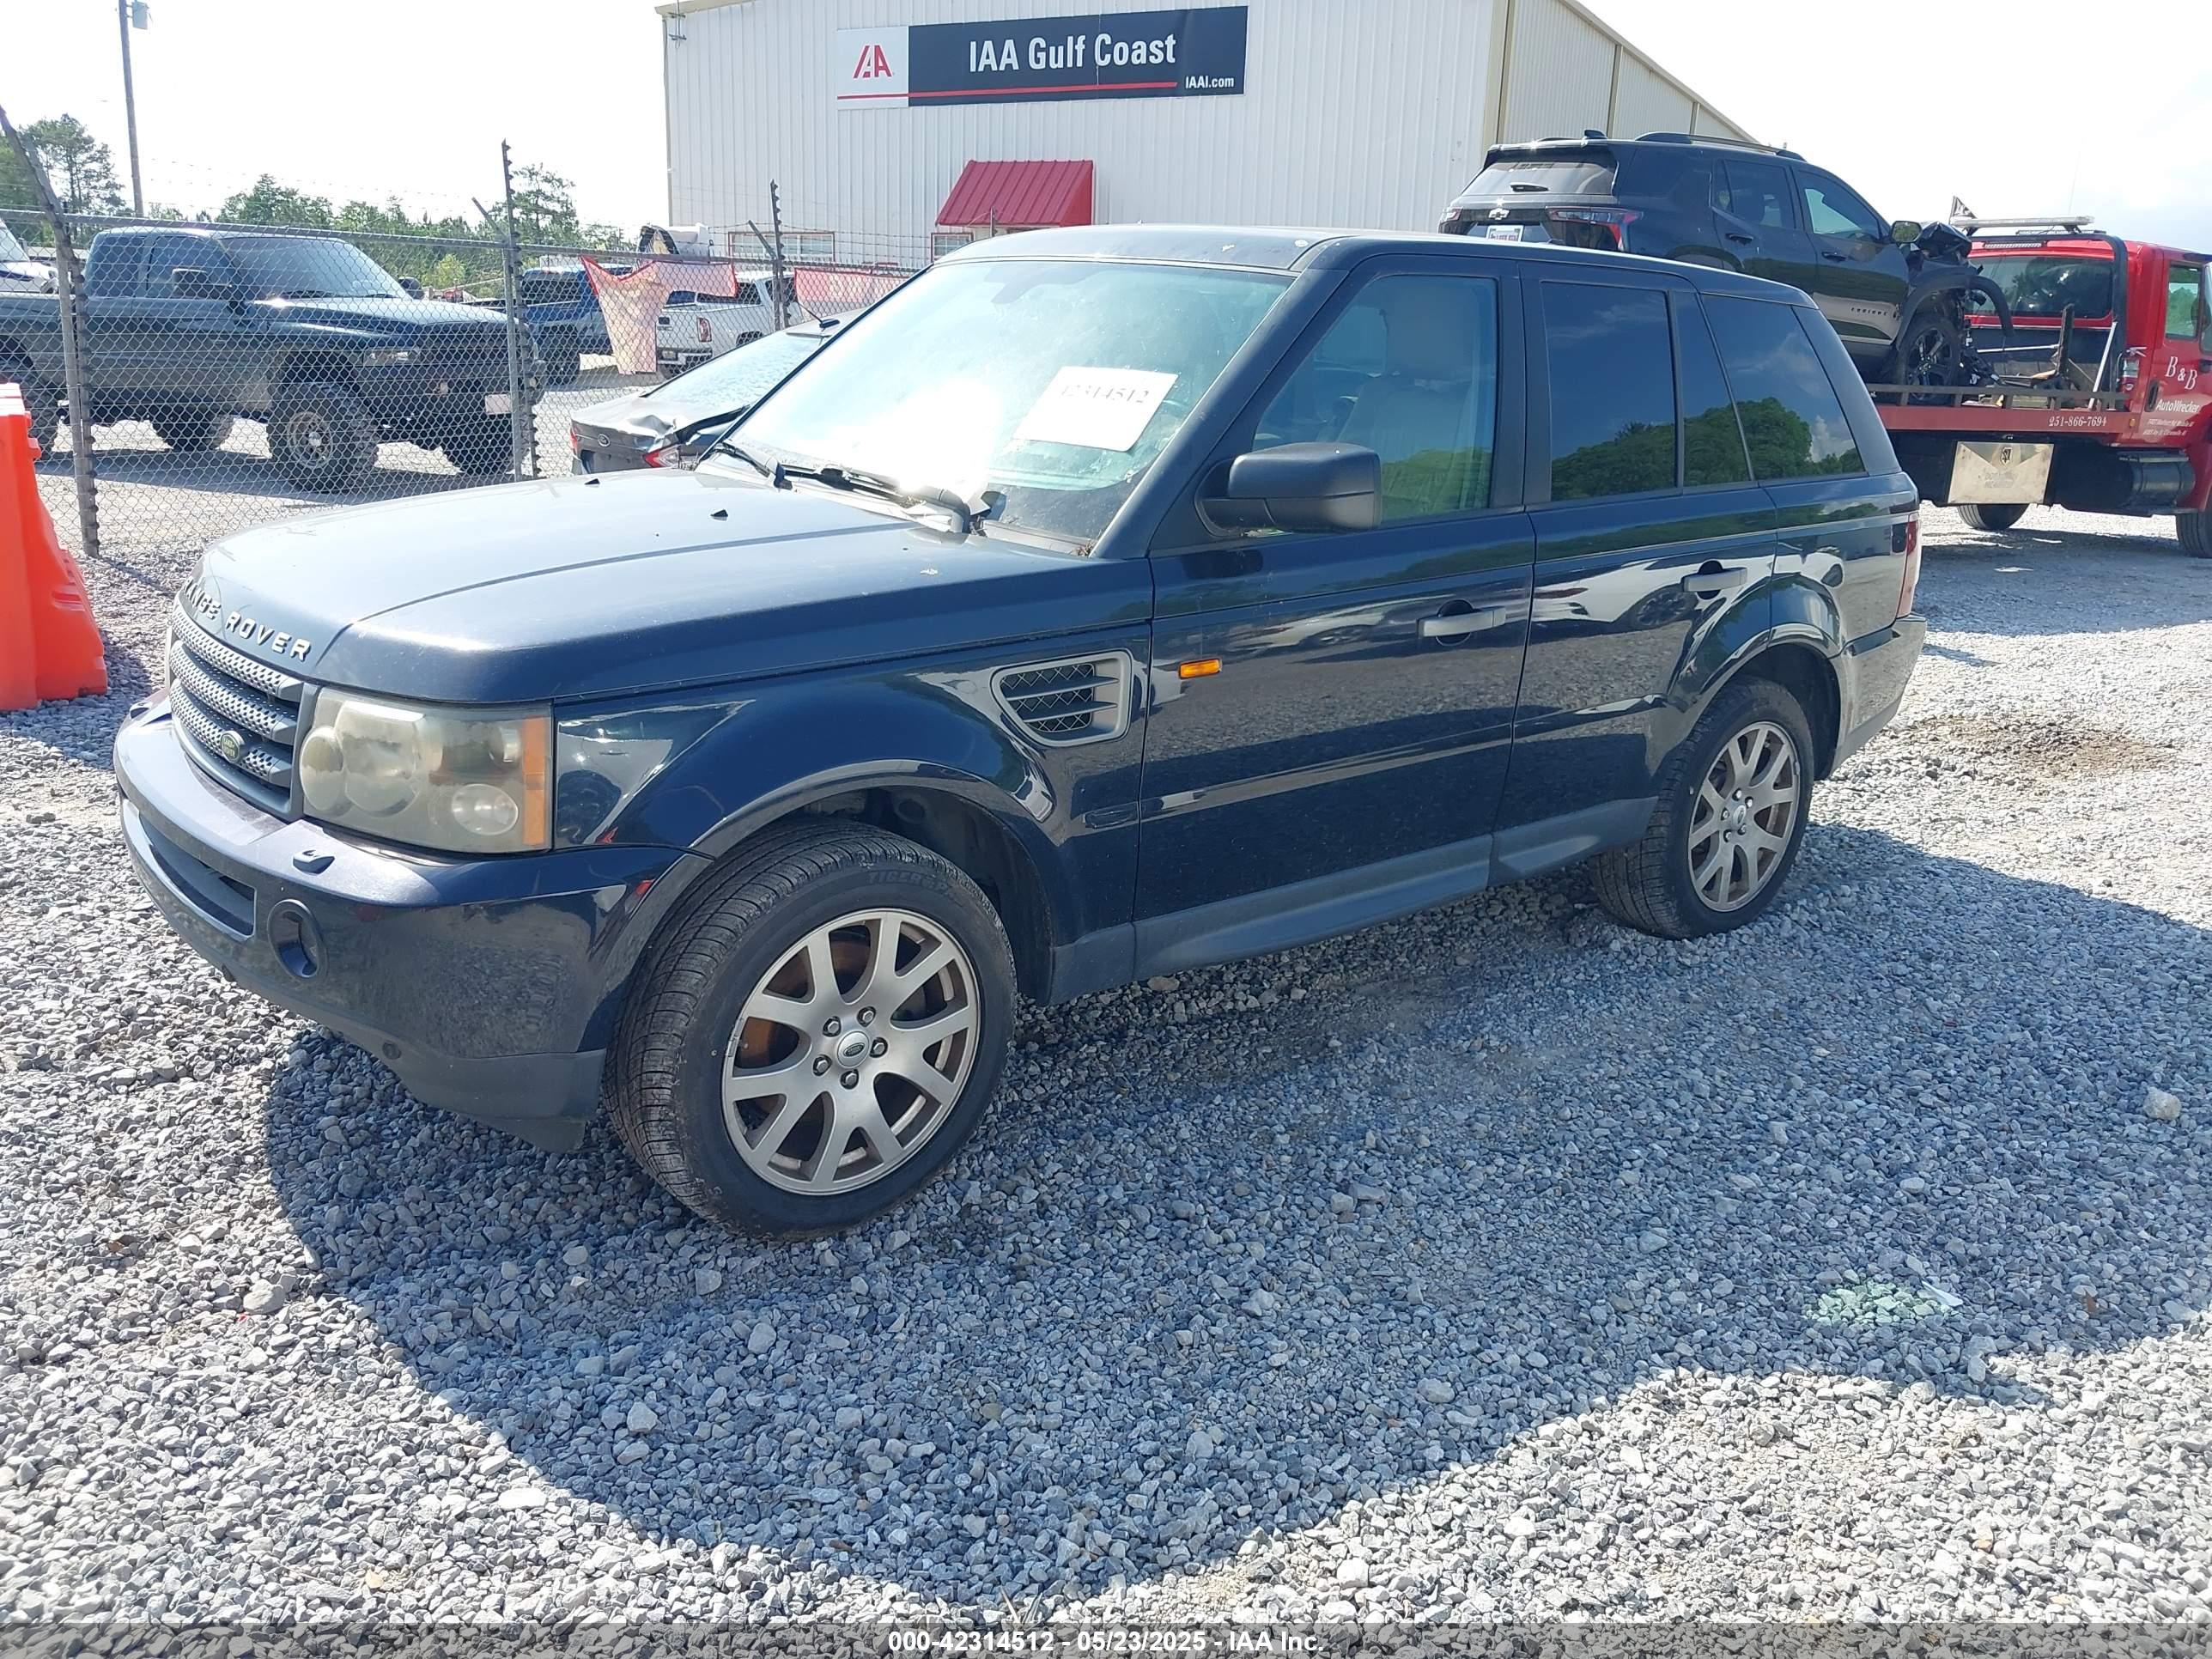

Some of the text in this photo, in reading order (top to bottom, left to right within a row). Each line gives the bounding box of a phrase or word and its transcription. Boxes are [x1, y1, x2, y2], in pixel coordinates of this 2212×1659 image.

[969, 33, 1176, 72] IAA Gulf Coast
[2165, 356, 2198, 390] B & B
[2048, 416, 2107, 427] 251-866-7694
[184, 576, 312, 662] RANGE ROVER
